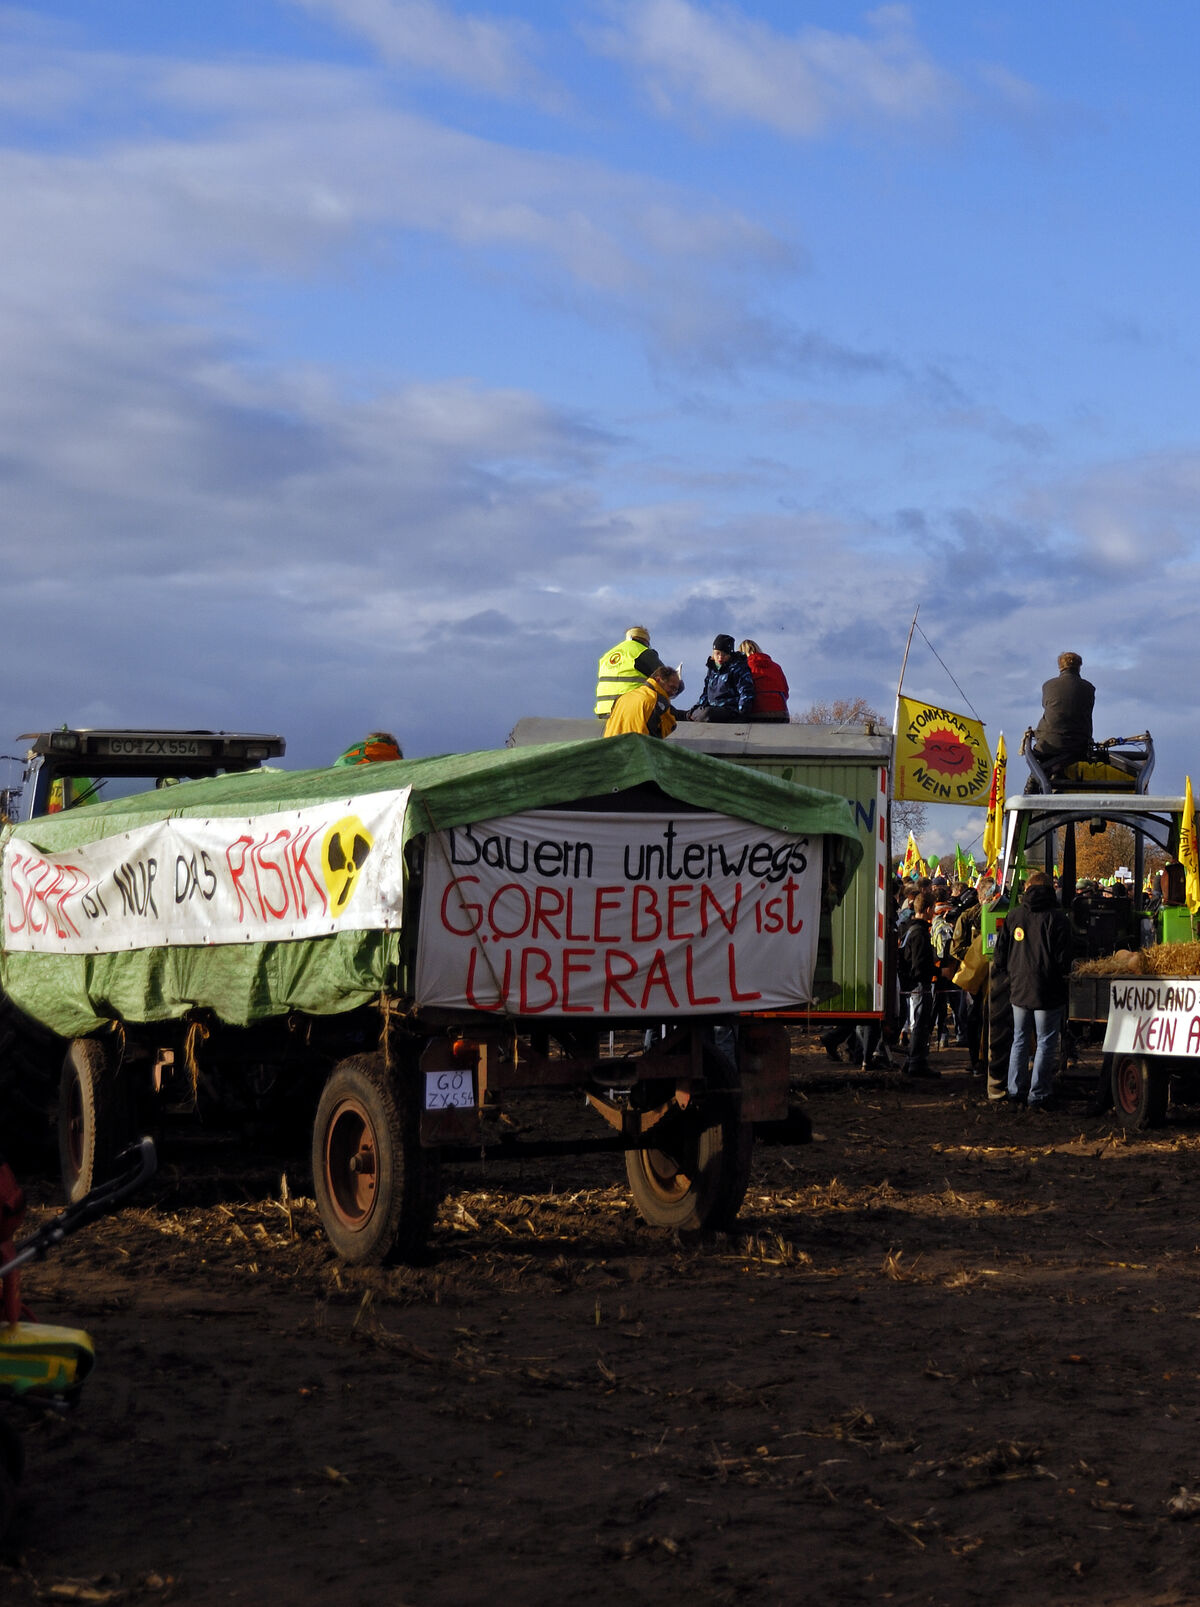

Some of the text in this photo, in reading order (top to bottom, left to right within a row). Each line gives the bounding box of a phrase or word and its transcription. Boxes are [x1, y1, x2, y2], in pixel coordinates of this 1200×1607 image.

[169, 740, 196, 754] 554
[912, 767, 951, 798] NEIN
[956, 757, 988, 798] DANKE
[450, 820, 808, 883] Bauern unterwegs
[113, 858, 159, 919] NUR
[175, 850, 217, 904] DAS
[440, 875, 804, 943] GORLEBEN ist
[1112, 985, 1197, 1012] WENDLAND
[1132, 1017, 1178, 1052] KEIN
[437, 1072, 464, 1090] GÖ
